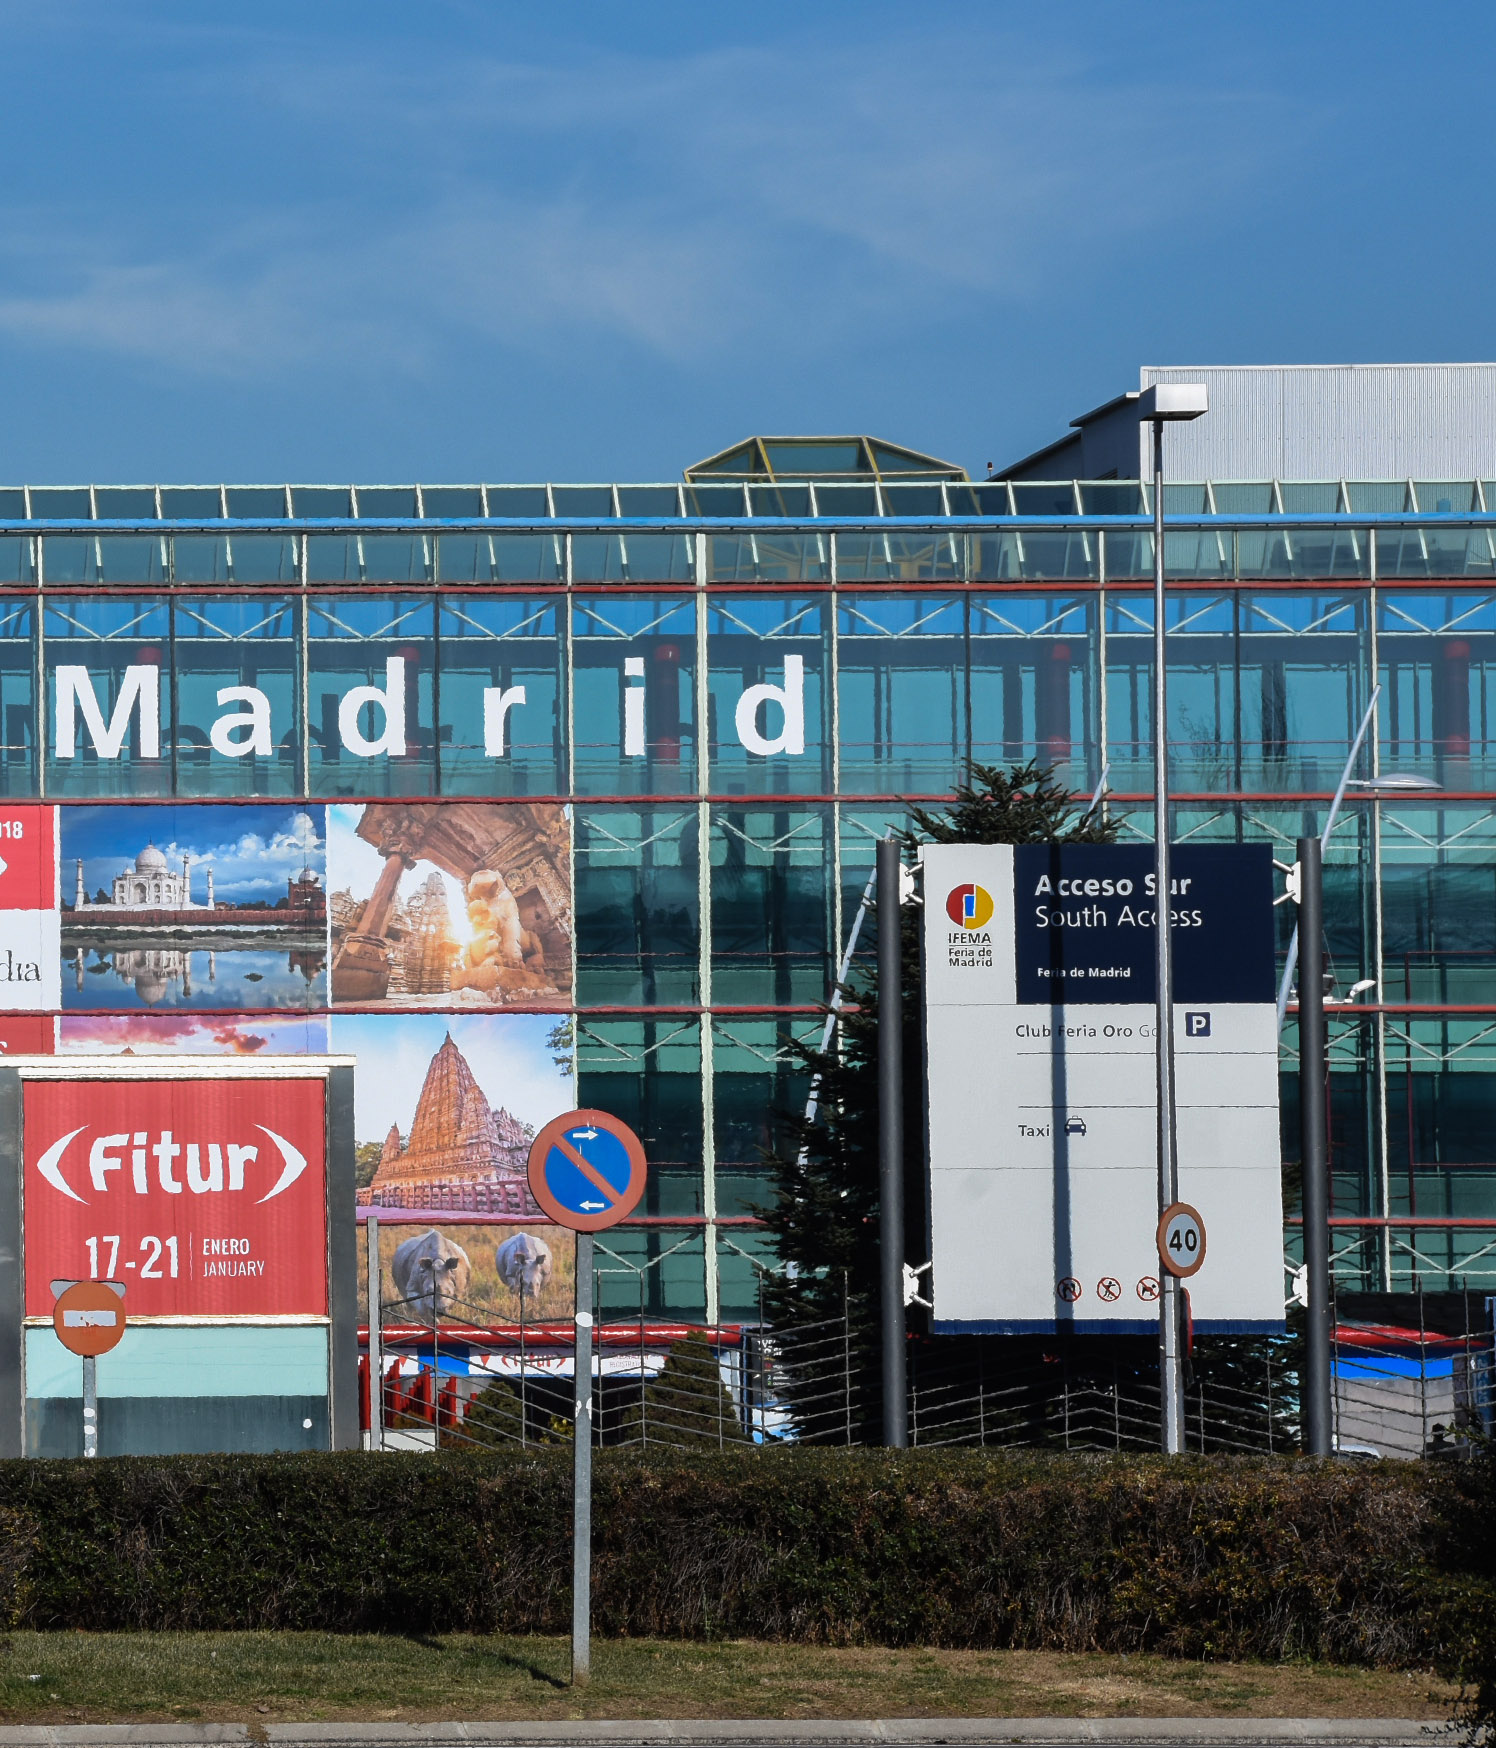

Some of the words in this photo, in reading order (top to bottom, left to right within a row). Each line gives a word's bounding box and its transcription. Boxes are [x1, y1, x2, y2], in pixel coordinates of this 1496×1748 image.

[56, 655, 804, 758] Madrid
[1034, 874, 1133, 896] Acceso
[1035, 904, 1107, 927] South
[948, 932, 992, 944] IFEMA
[949, 947, 974, 957] Feria
[978, 947, 993, 957] de
[949, 957, 993, 967] Madrid
[1037, 967, 1066, 978] Feria
[1070, 967, 1085, 978] de
[1088, 967, 1131, 978] Madrid
[1015, 1024, 1051, 1037] Club
[1058, 1024, 1097, 1037] Feria
[1103, 1024, 1133, 1037] Oro
[1017, 1124, 1050, 1137] Taxi
[89, 1130, 258, 1194] Fitur
[1169, 1229, 1197, 1252] 40
[85, 1235, 179, 1279] 17-21
[203, 1238, 250, 1255] ENERO
[203, 1260, 265, 1278] JANUARY
